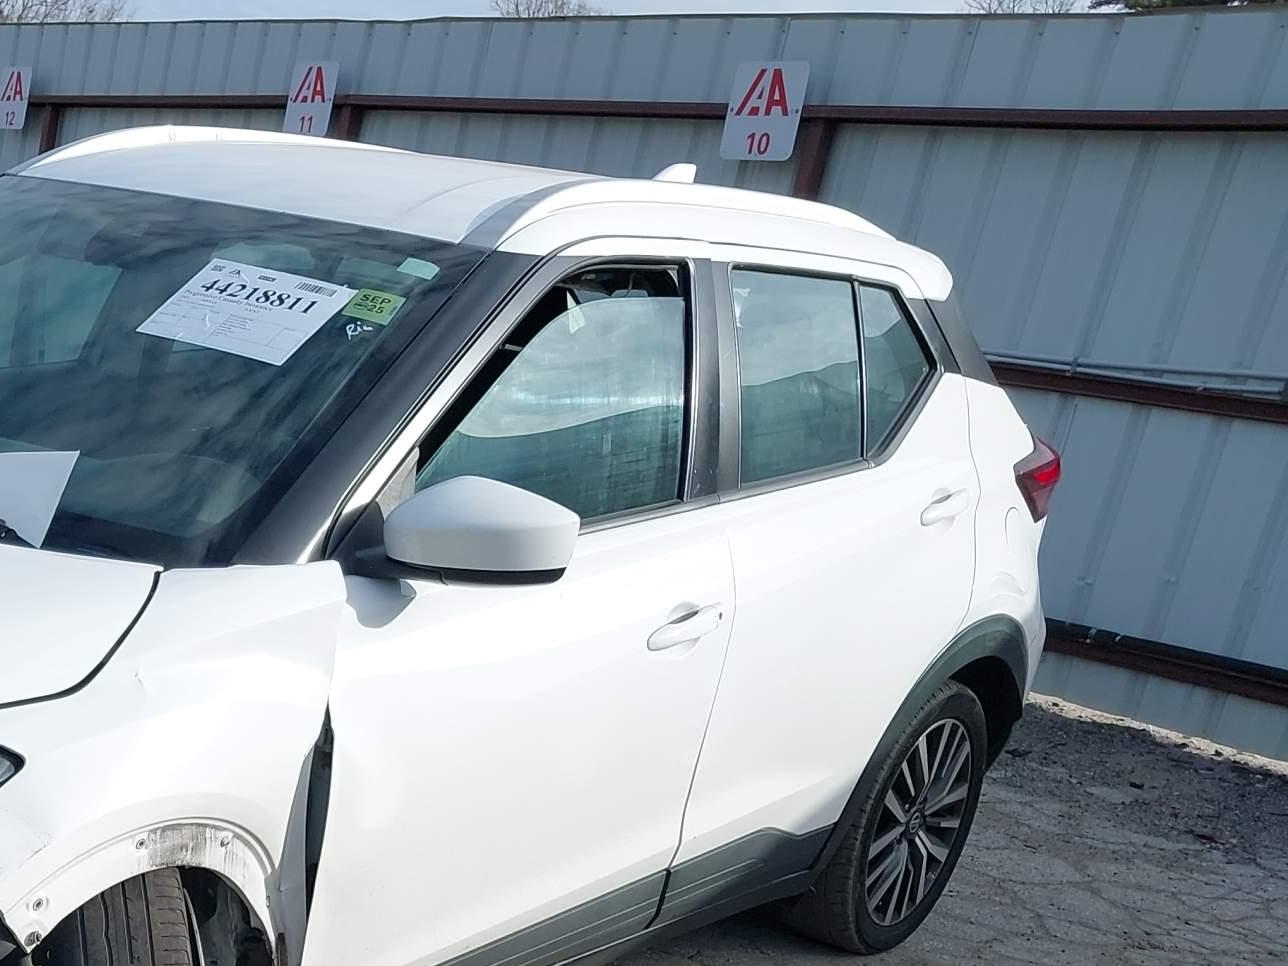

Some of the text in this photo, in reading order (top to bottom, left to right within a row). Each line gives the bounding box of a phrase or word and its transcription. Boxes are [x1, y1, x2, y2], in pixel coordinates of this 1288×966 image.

[6, 111, 16, 127] 12
[299, 115, 313, 133] 11
[747, 132, 770, 155] 10
[200, 279, 319, 314] 44218811
[360, 293, 392, 306] SEP
[367, 304, 386, 314] 25
